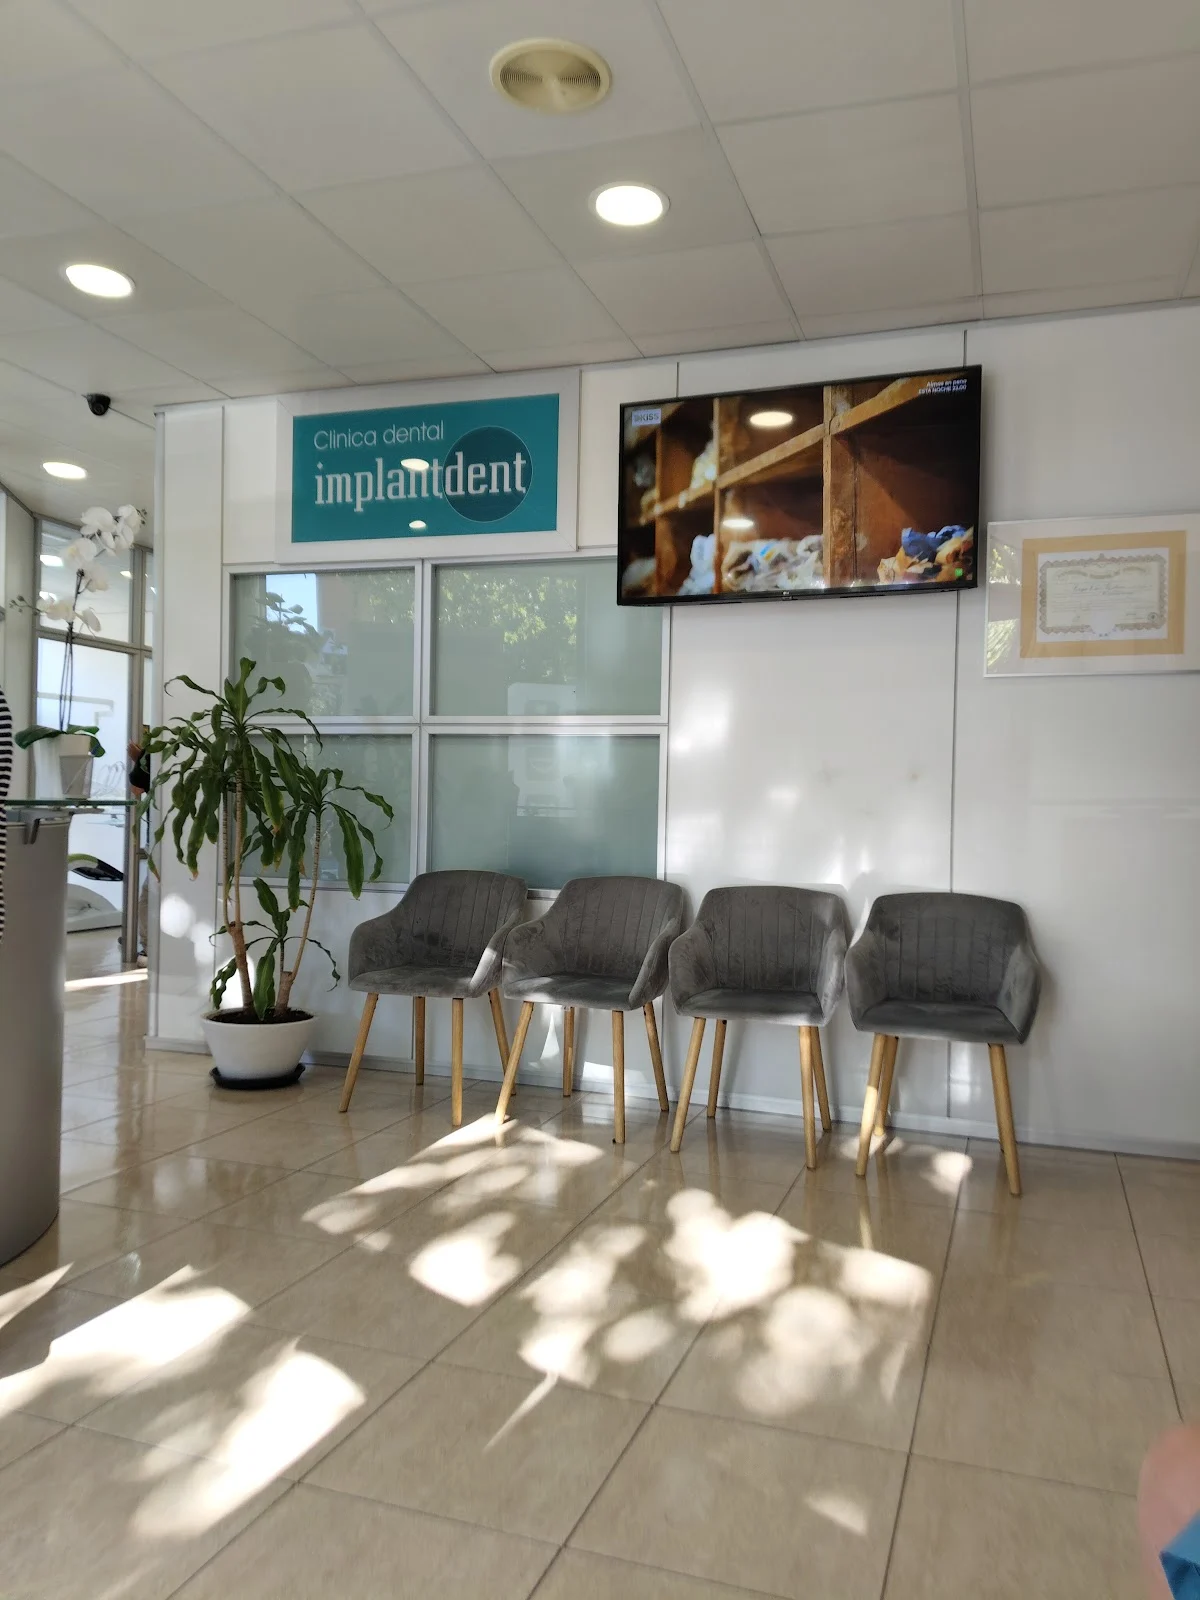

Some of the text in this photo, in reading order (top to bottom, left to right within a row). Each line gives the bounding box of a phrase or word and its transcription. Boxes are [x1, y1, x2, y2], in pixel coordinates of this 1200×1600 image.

[932, 385, 951, 393] NOCHE
[383, 420, 444, 444] dental
[315, 452, 527, 513] implantdent
